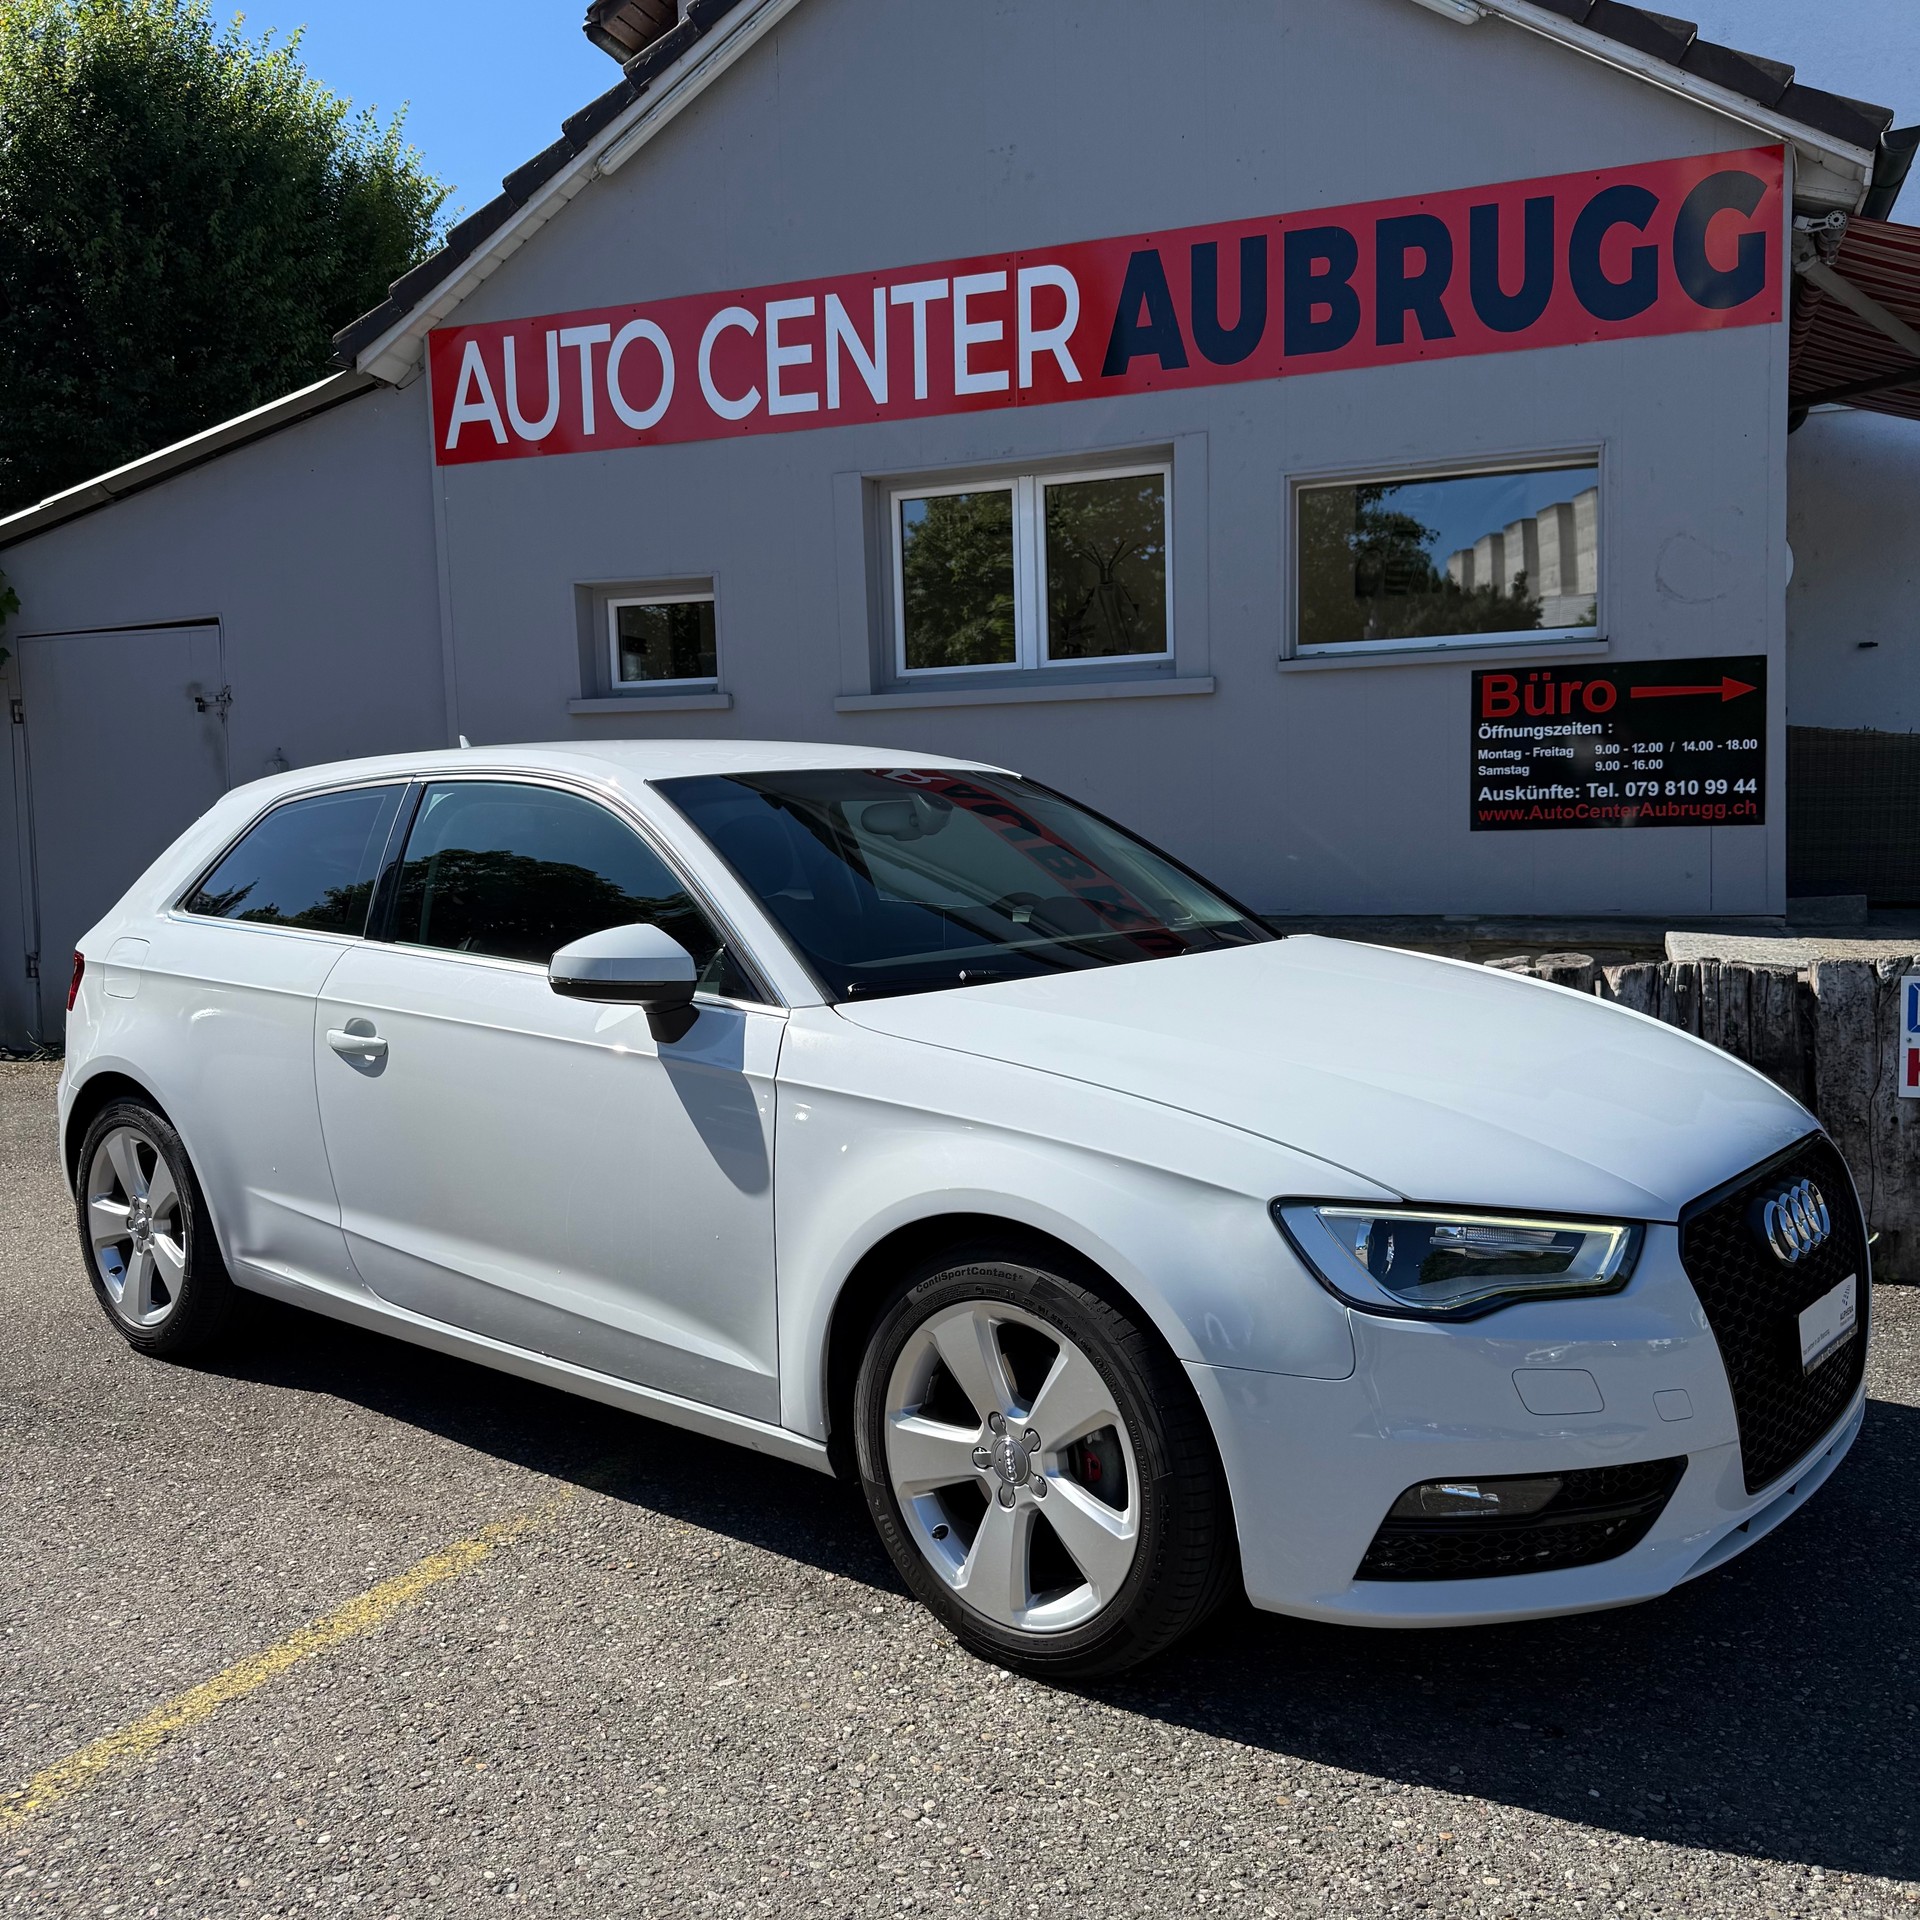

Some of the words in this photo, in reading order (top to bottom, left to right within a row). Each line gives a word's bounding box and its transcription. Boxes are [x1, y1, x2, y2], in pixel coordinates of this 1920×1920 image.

[445, 319, 676, 450] AUTO
[698, 264, 1083, 420] CENTER
[1101, 170, 1768, 377] AUBRUGG
[1482, 673, 1617, 718] Büro
[1478, 722, 1602, 740] Öffnungszeiten
[1478, 749, 1522, 760] Montag
[1533, 747, 1574, 759] Freitag
[1595, 744, 1620, 755] 9.00
[1632, 742, 1663, 754] 12.00
[1682, 740, 1714, 752] 14.00
[1726, 739, 1758, 750] 18.00
[1478, 765, 1530, 777] Samstag
[1595, 760, 1620, 772] 9.00
[1632, 759, 1663, 771] 16.00
[1478, 784, 1581, 802] Auskünfte:
[1586, 782, 1619, 798] Tel.
[1625, 781, 1659, 797] 079
[1665, 780, 1699, 796] 810
[1705, 779, 1728, 795] 99
[1733, 778, 1757, 794] 44
[1478, 800, 1757, 821] www.AutoCenterAubrugg.ch
